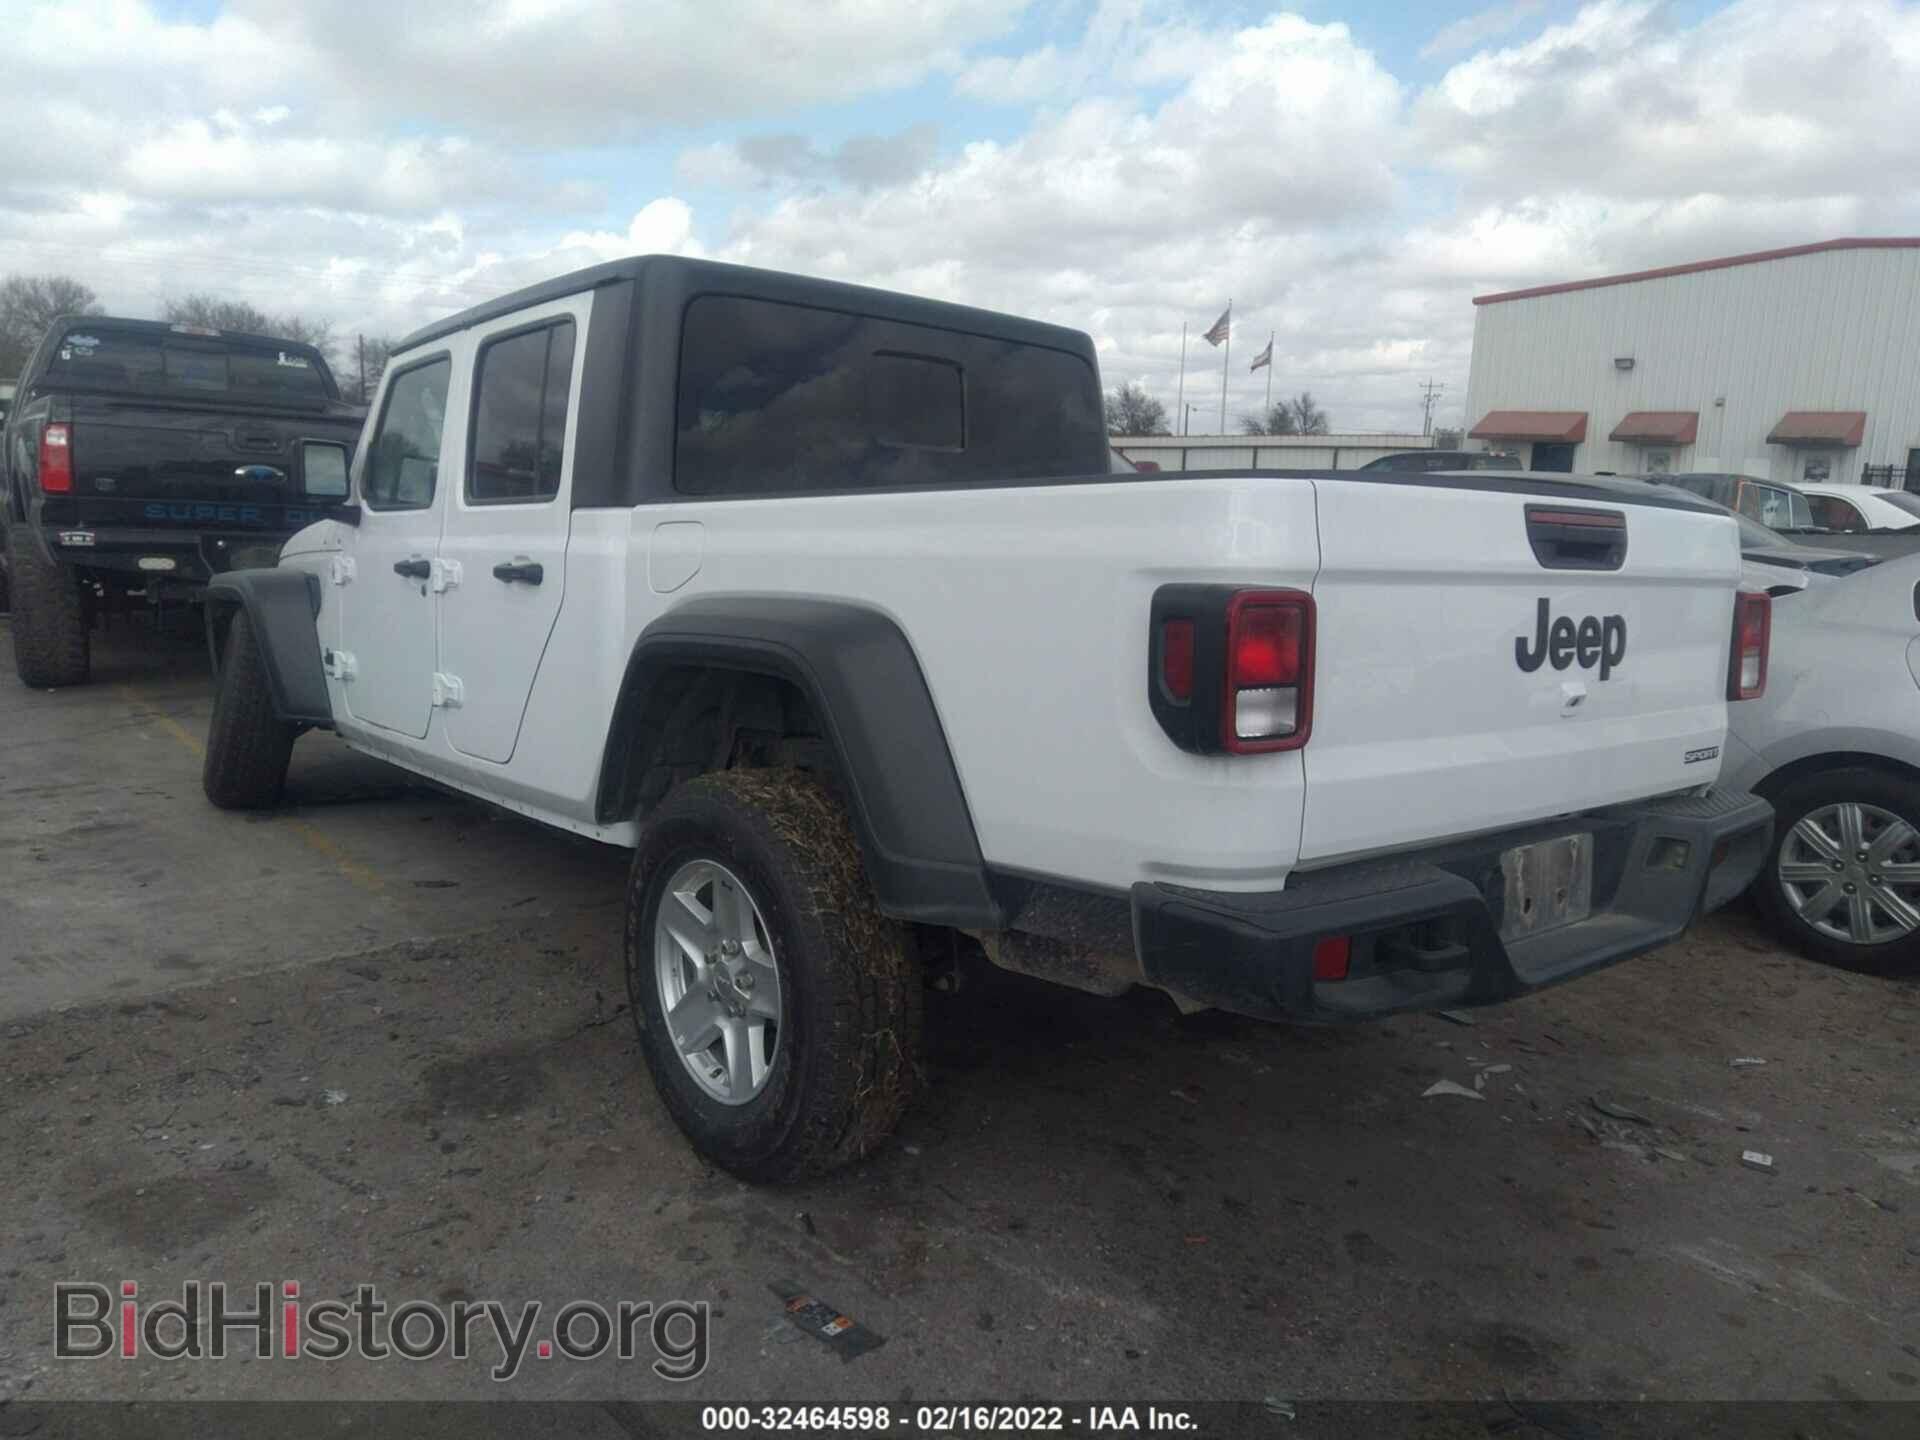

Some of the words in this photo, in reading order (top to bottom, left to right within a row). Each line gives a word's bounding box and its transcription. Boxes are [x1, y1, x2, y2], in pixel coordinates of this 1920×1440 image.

[144, 503, 258, 522] SUPER
[1515, 598, 1626, 681] Jeep
[1684, 746, 1720, 764] SPORT
